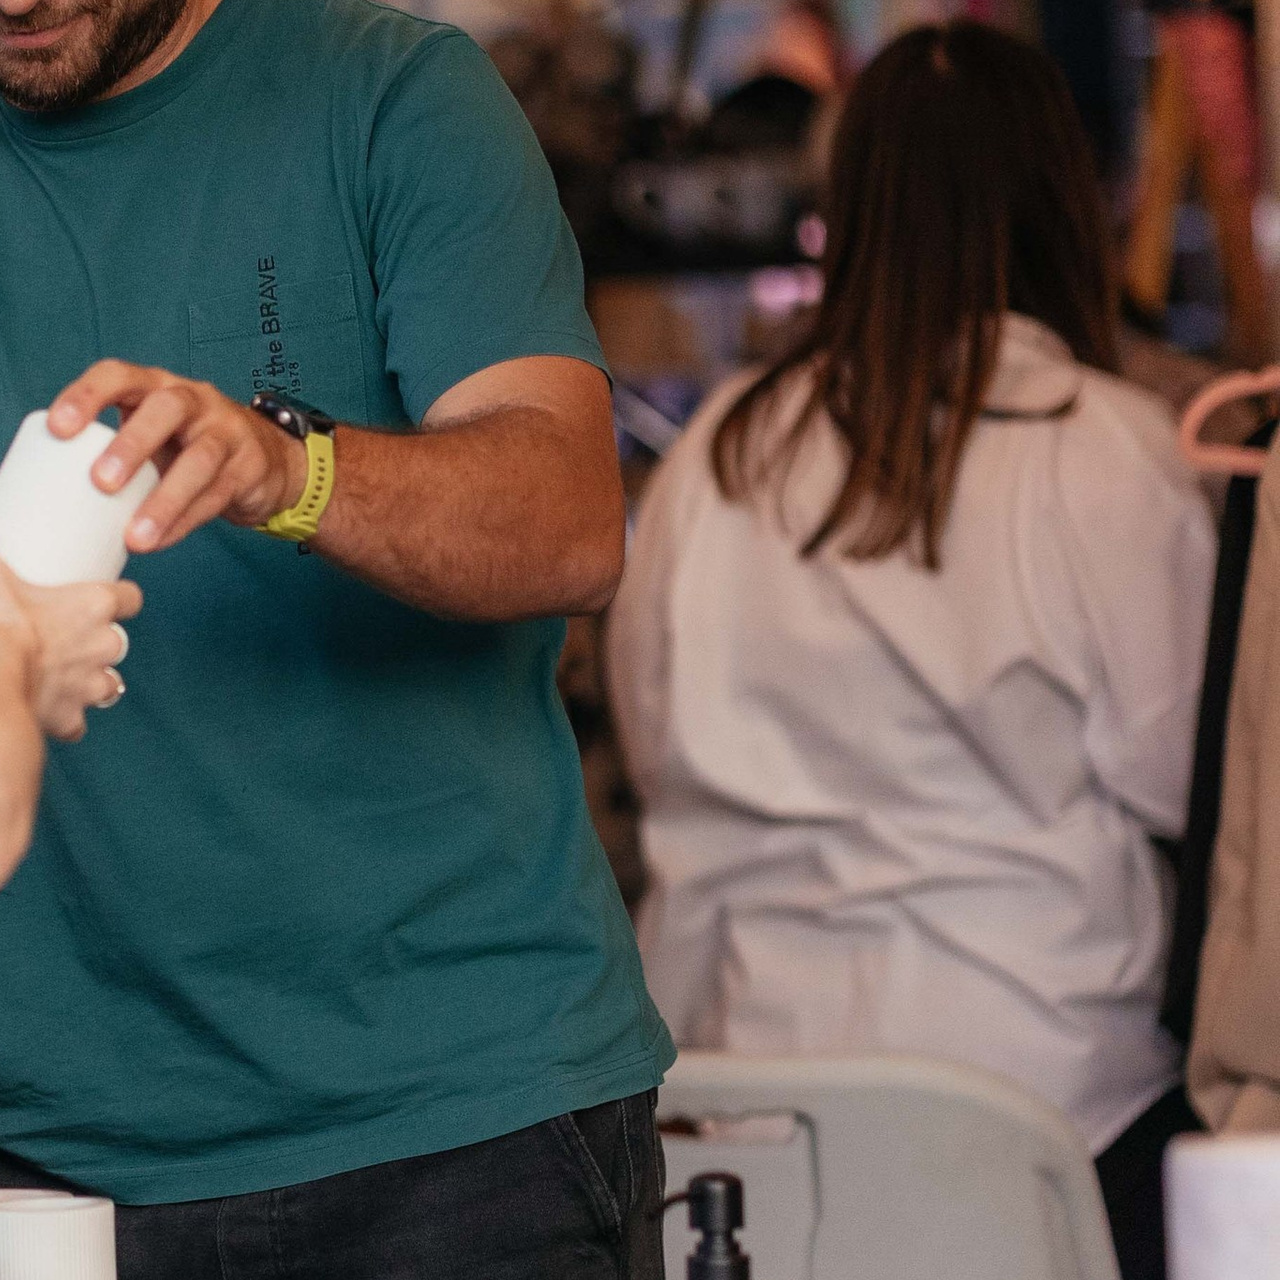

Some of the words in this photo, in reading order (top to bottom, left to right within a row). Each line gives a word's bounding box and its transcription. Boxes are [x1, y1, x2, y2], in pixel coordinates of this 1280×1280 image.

[258, 255, 280, 335] BRAVE
[266, 340, 285, 377] the
[289, 361, 302, 395] 1978
